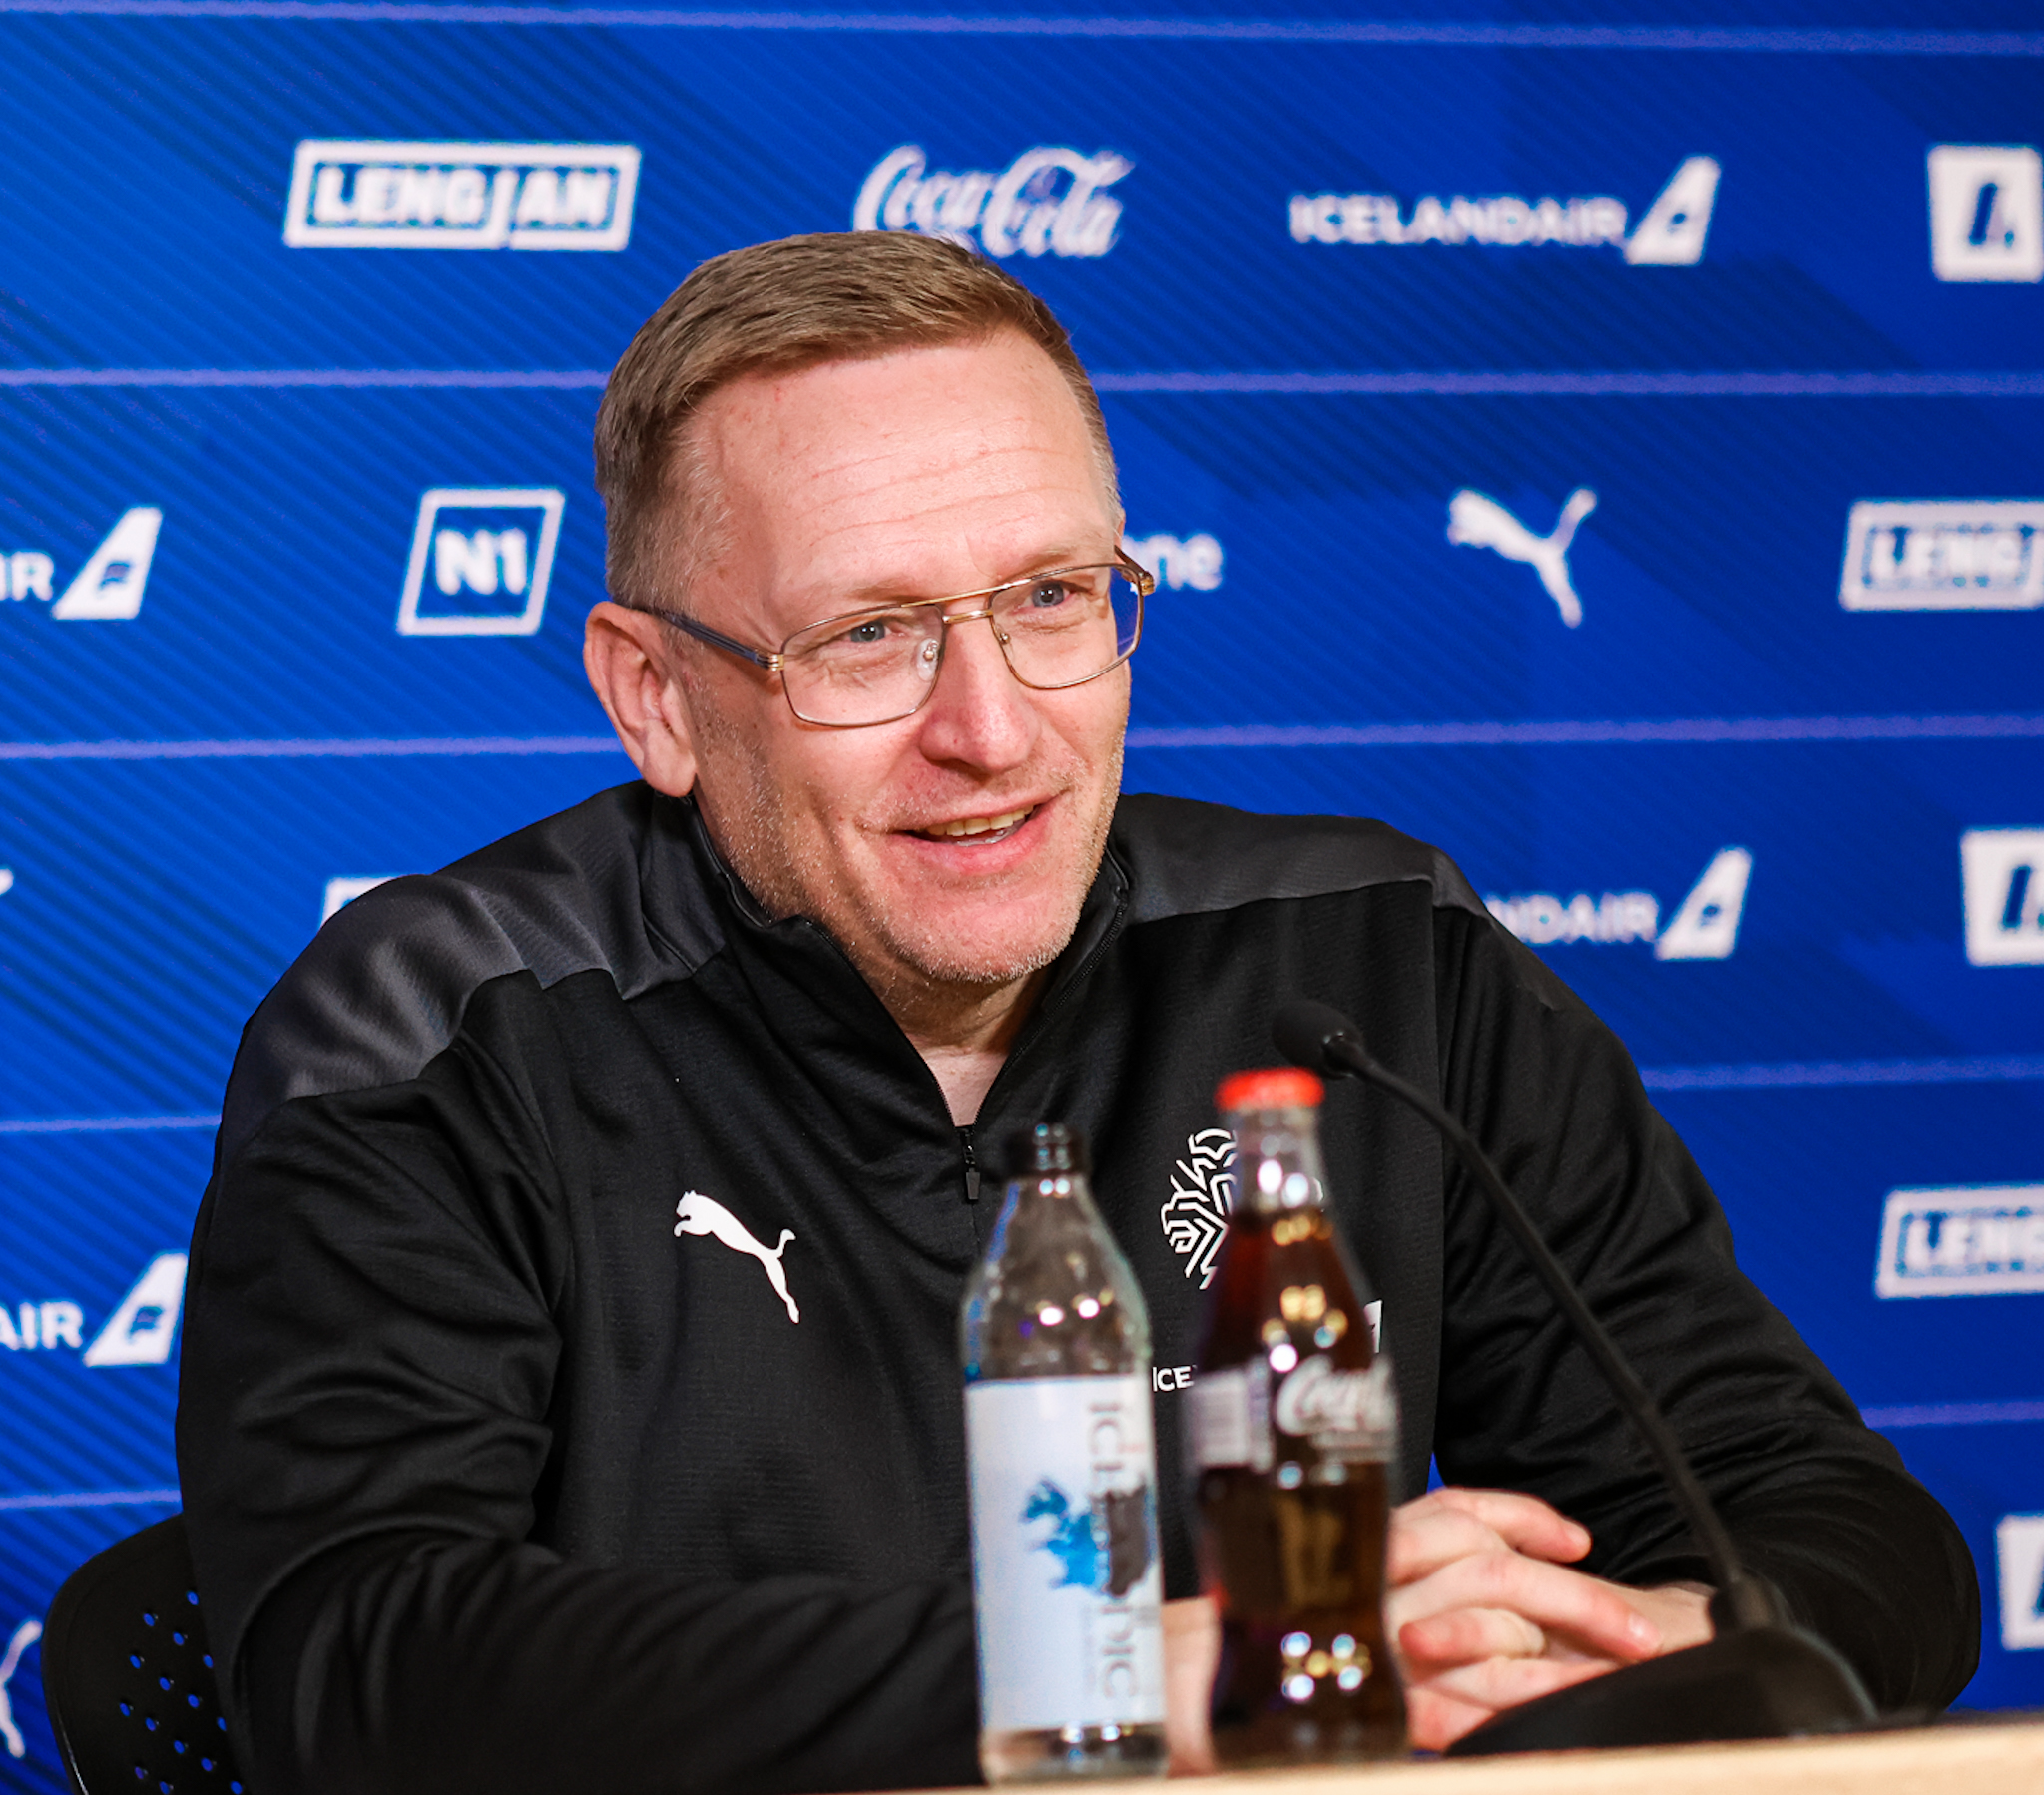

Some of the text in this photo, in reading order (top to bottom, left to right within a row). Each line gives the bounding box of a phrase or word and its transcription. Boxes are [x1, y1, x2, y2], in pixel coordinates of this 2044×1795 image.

[313, 166, 612, 239] LENGJAN
[1290, 195, 1627, 246] ICELANDAIR
[435, 527, 527, 595] N1
